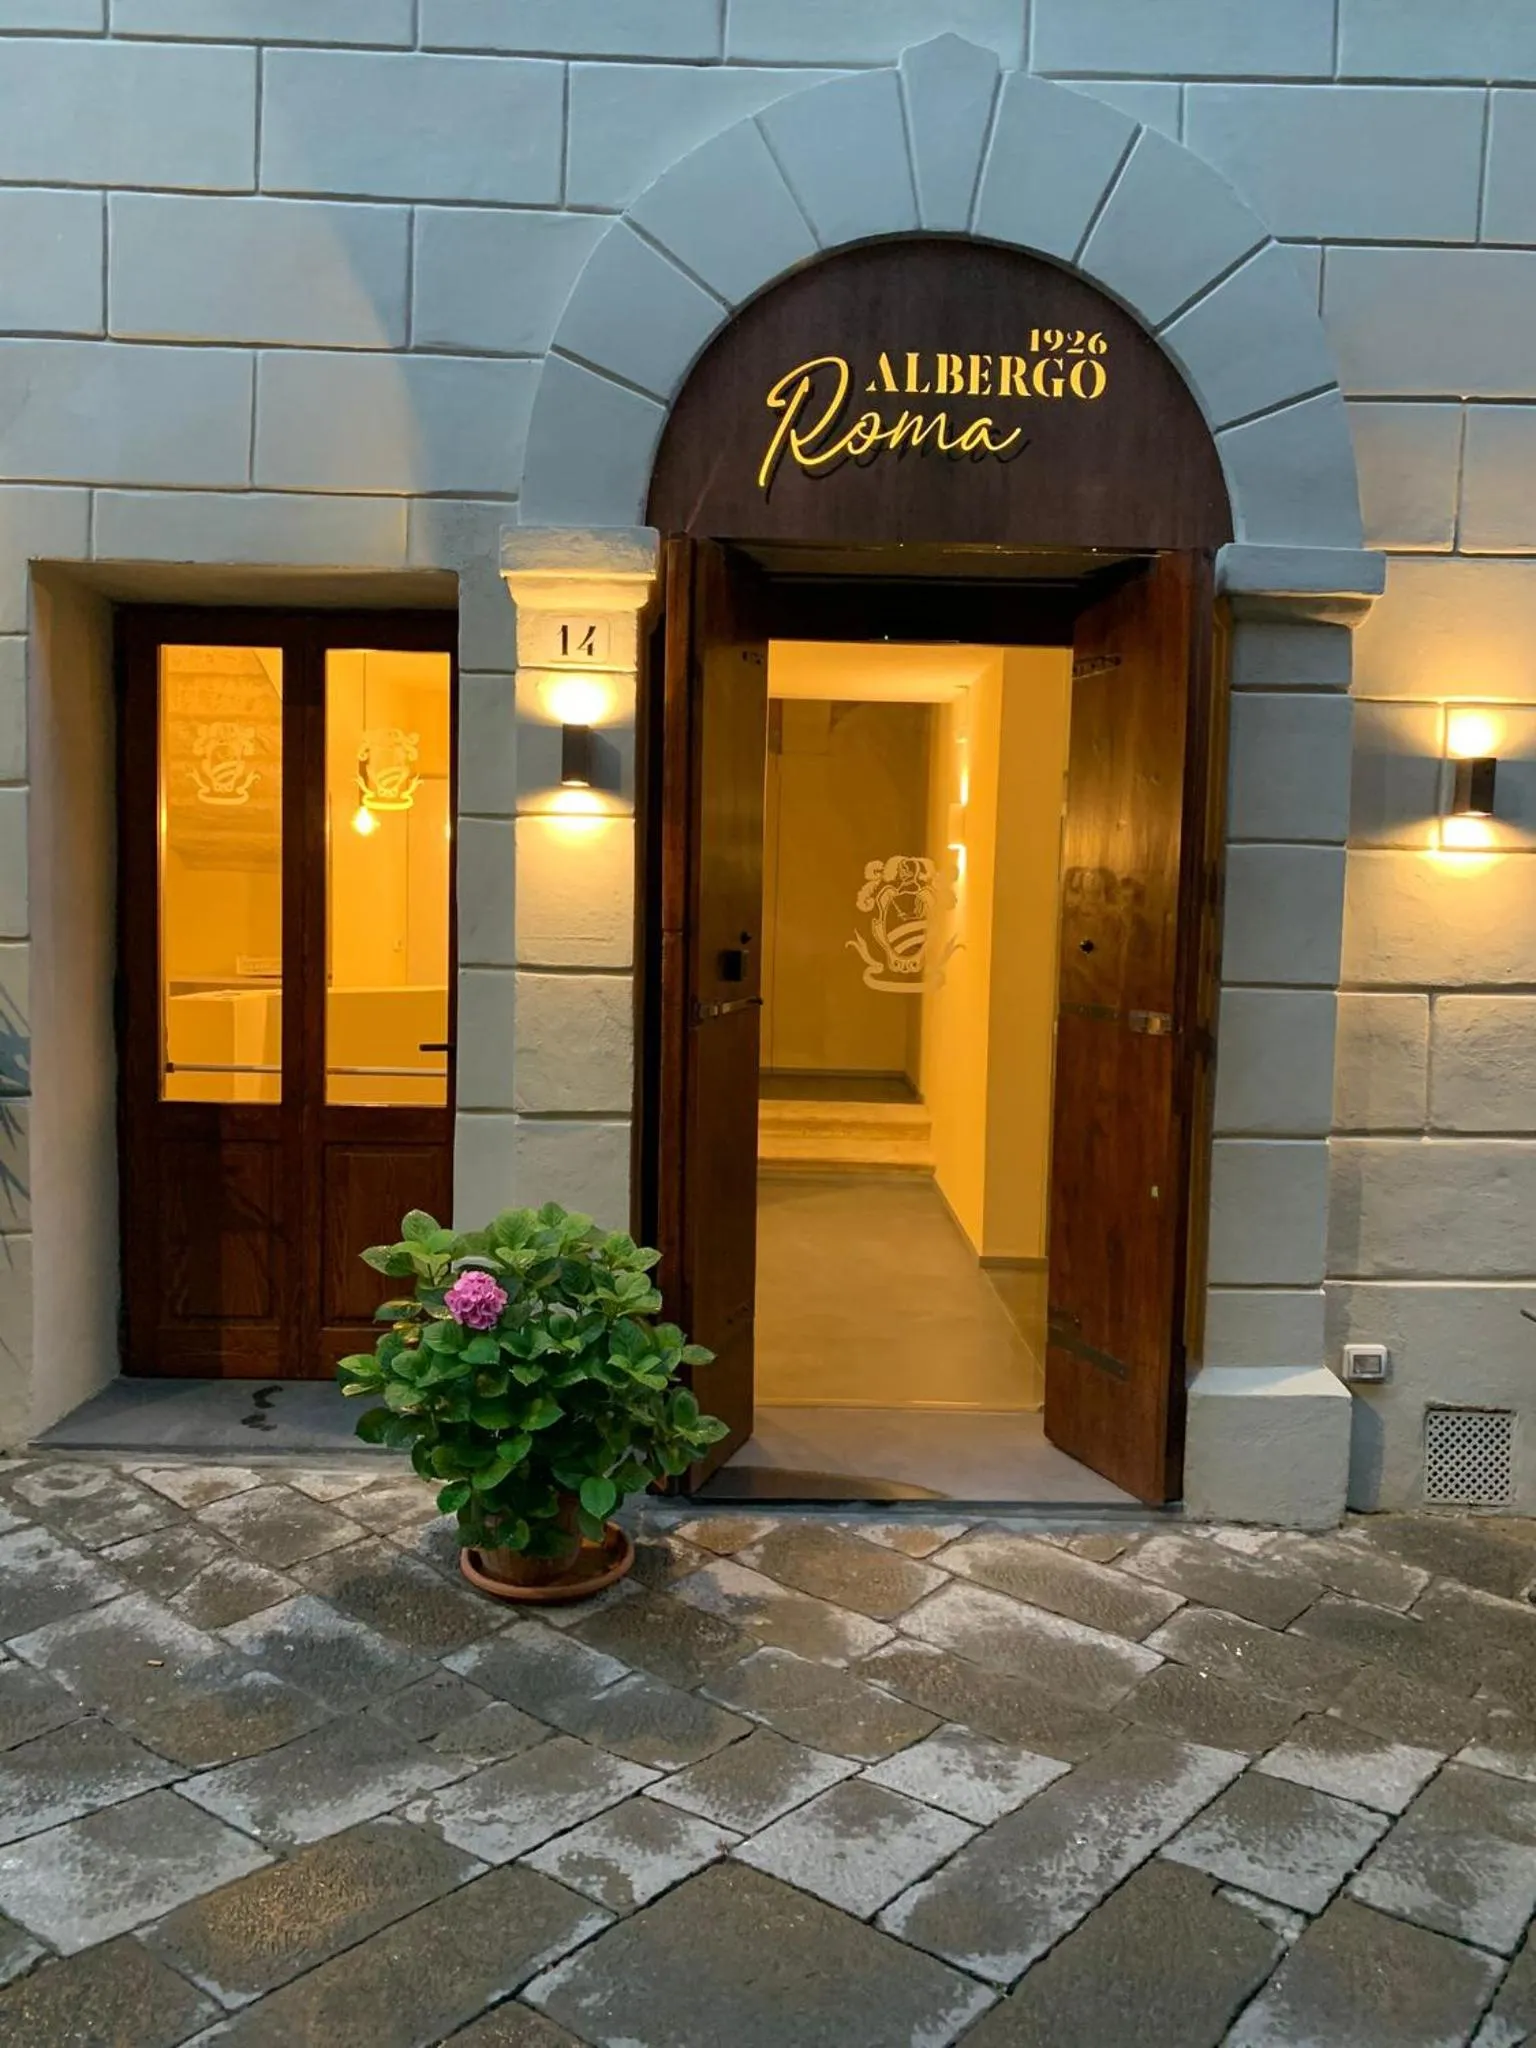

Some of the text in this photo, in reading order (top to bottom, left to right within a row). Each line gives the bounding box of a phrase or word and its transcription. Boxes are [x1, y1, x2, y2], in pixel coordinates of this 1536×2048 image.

[1029, 328, 1108, 355] 1926
[865, 351, 1107, 400] ALBERGO
[758, 356, 1022, 487] Roma
[557, 624, 597, 656] 14
